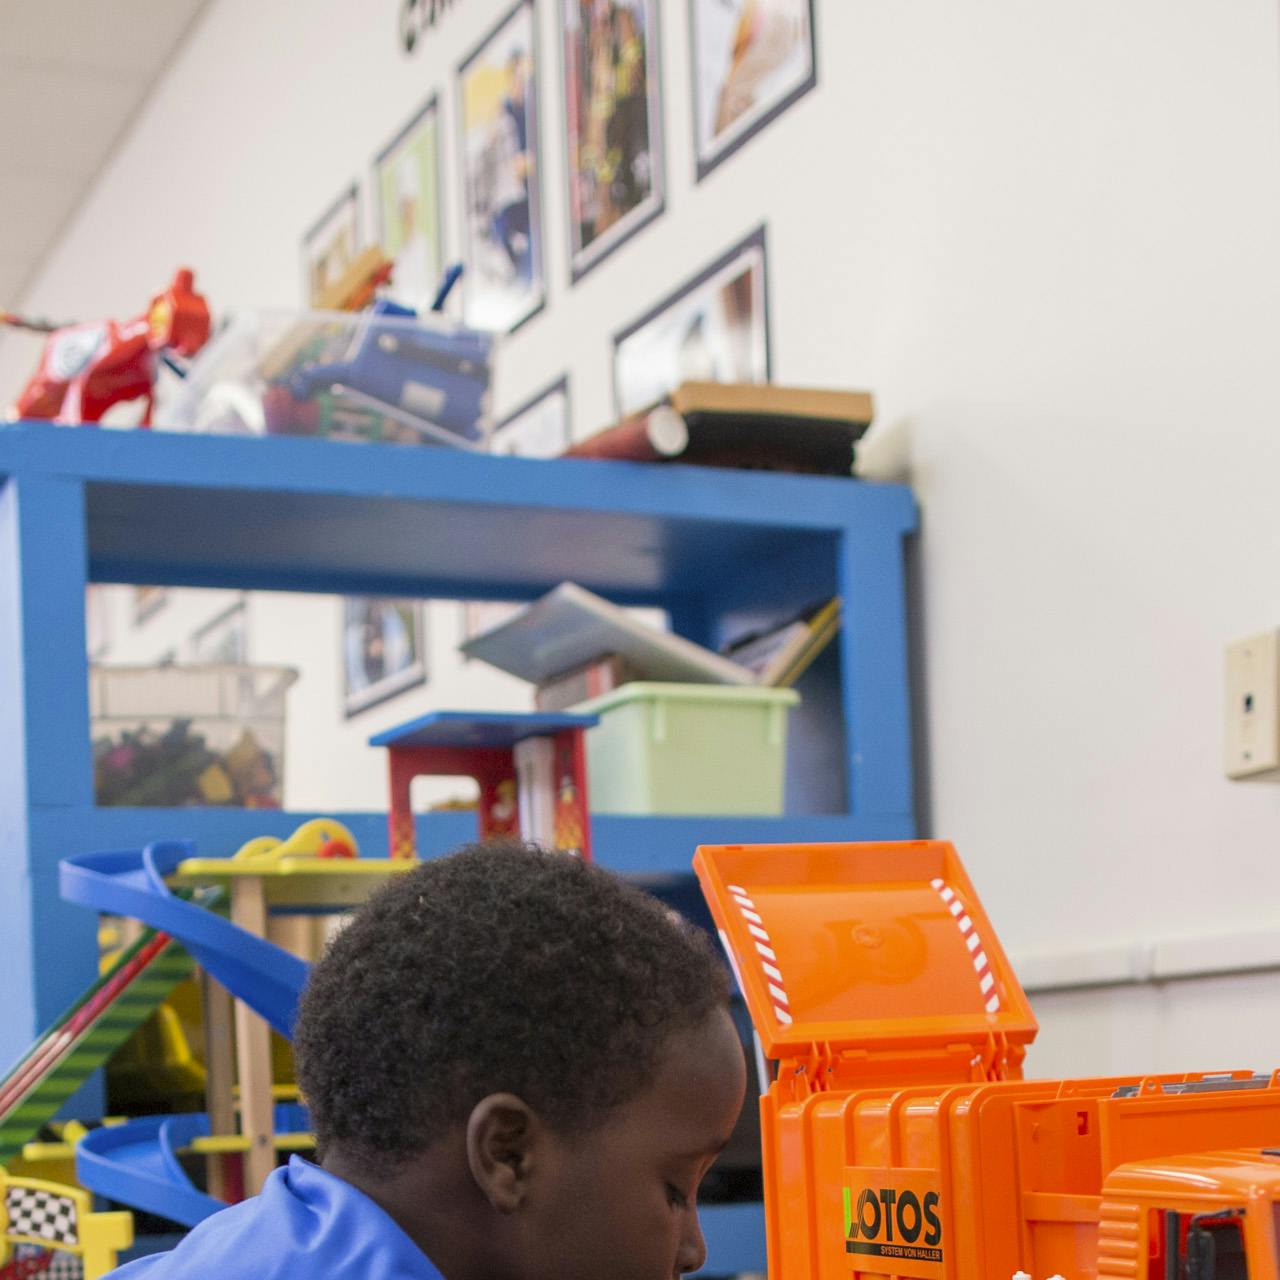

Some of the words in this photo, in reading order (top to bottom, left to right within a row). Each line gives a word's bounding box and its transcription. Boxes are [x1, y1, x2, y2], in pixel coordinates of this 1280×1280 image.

[842, 1187, 942, 1246] LOTOS
[880, 1245, 903, 1257] SYSTEM
[904, 1247, 916, 1259] VON
[917, 1249, 941, 1261] HALLER
